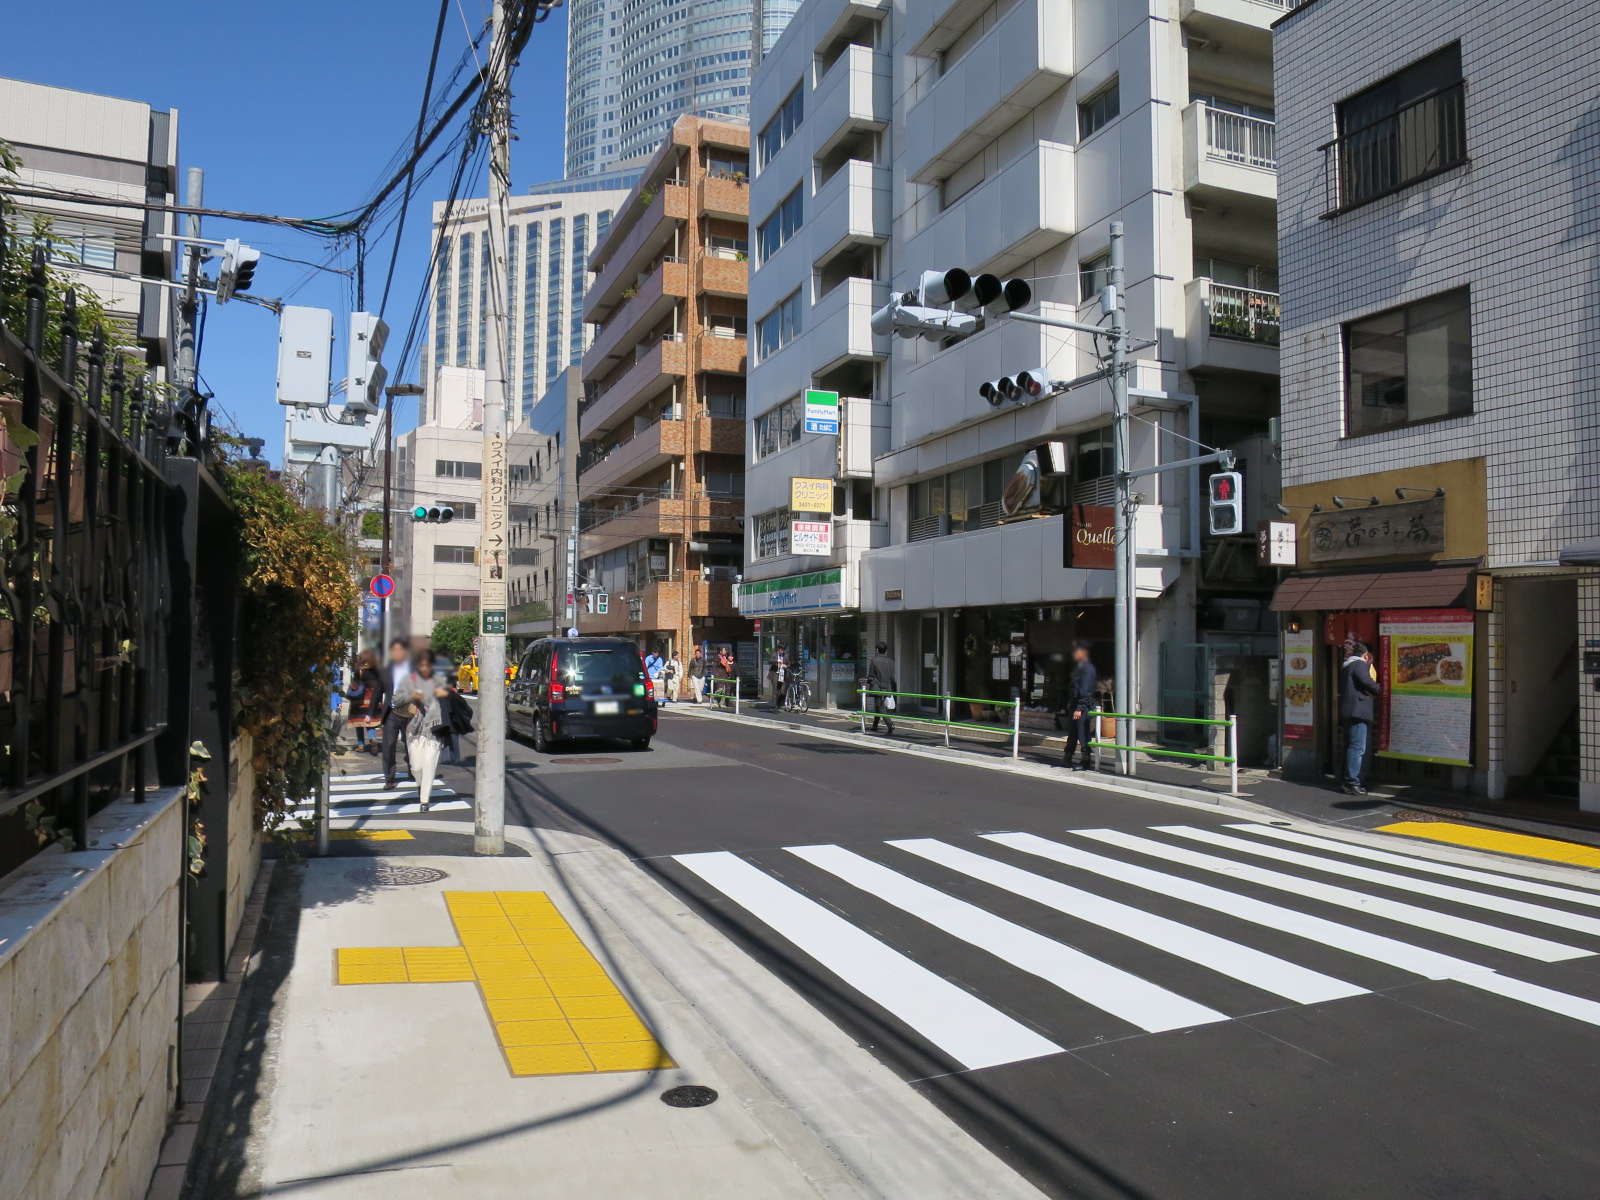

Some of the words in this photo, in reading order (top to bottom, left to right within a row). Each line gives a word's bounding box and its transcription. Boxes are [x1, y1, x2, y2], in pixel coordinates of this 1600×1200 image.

[490, 441, 503, 530] ウスイ内科クリニック
[794, 481, 829, 490] ウスイ内科
[794, 491, 829, 500] クリニック
[794, 532, 829, 543] ヒルサイド薬局
[770, 590, 797, 607] FamilyMart
